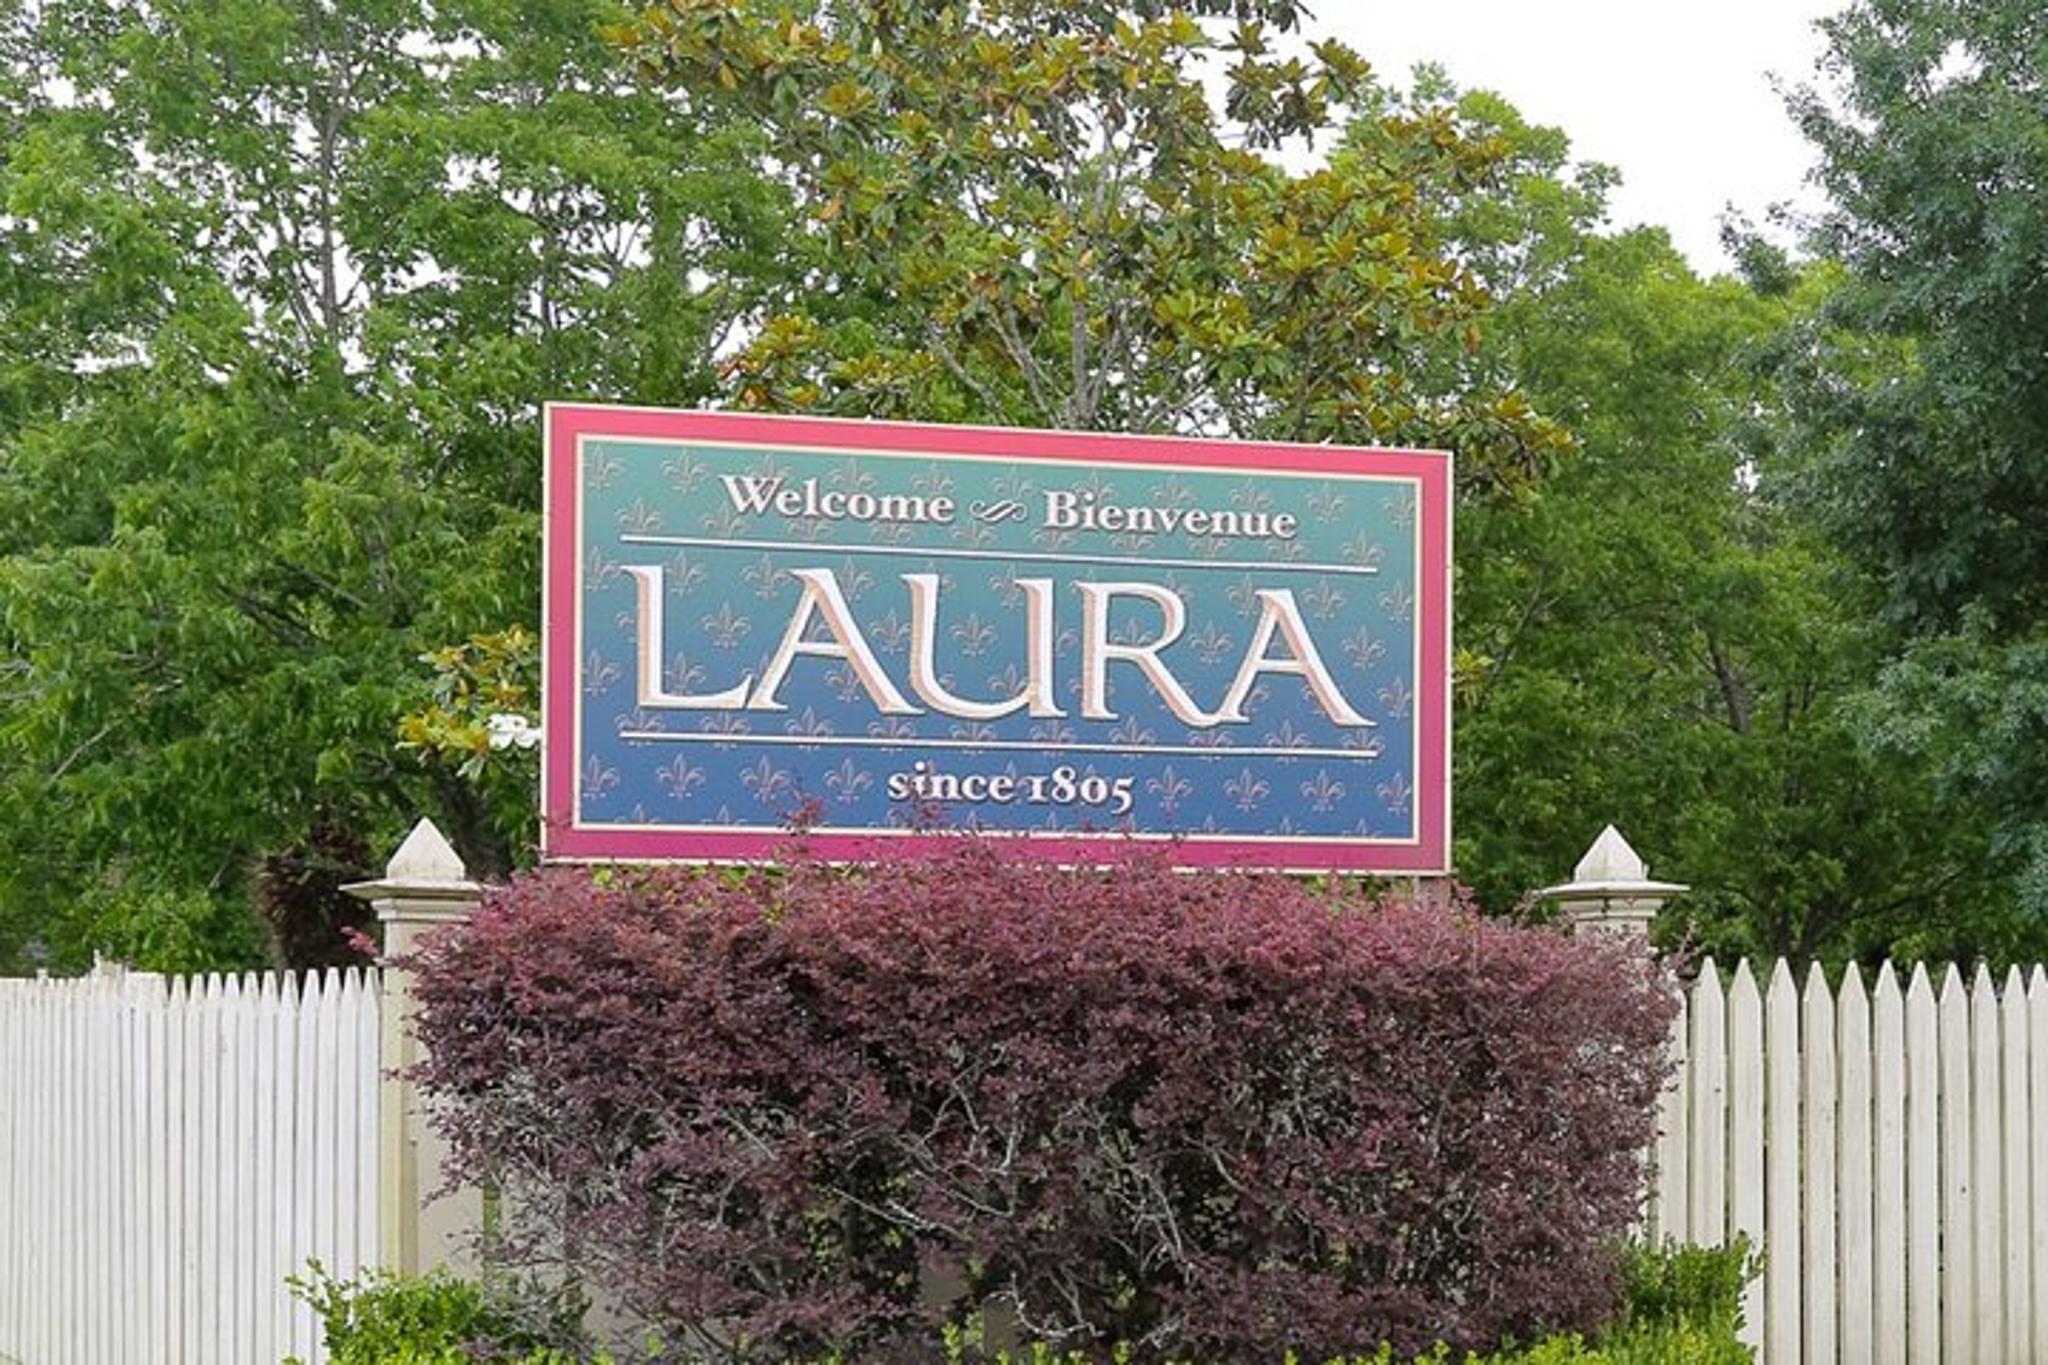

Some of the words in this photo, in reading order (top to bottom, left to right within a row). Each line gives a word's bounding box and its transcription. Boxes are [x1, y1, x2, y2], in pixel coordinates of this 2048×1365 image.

[720, 474, 955, 524] Welcome
[1043, 490, 1298, 539] Bienvenue
[620, 564, 1378, 728] LAURA
[887, 760, 1015, 804] since
[1029, 766, 1134, 815] 1805
